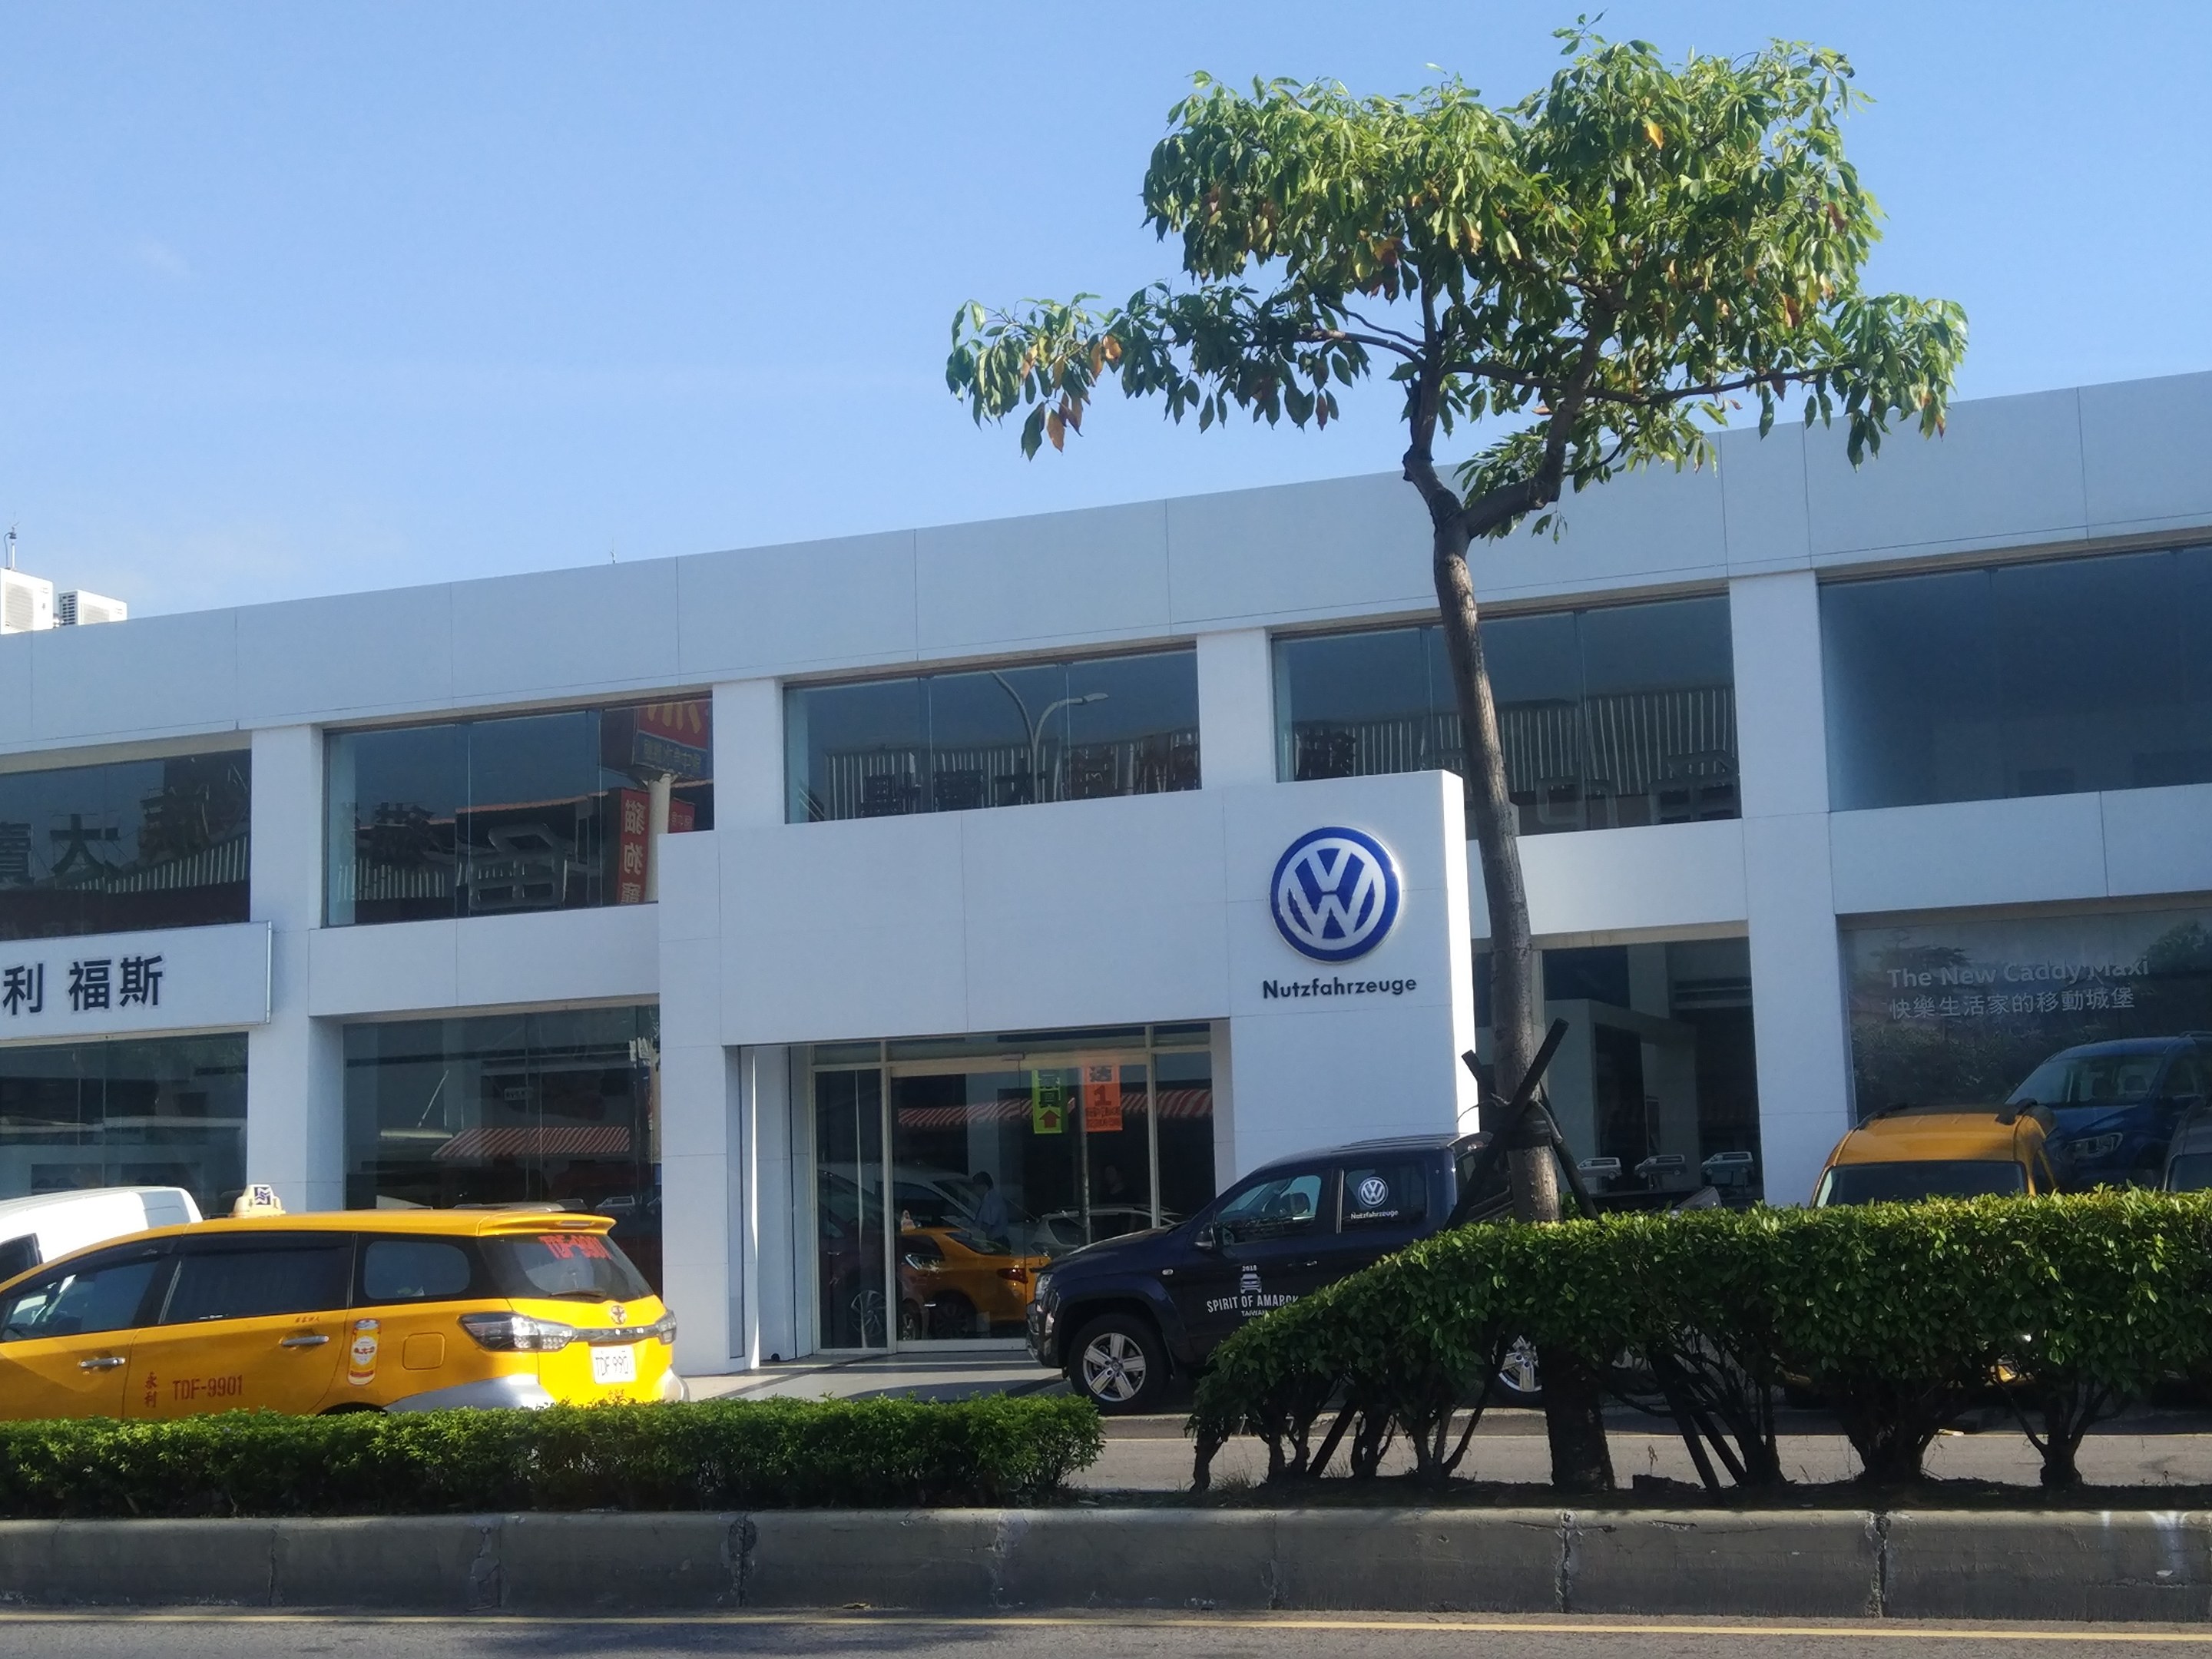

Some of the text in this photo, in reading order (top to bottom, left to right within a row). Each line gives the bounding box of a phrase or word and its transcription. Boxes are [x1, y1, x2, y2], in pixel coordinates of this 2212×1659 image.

[1887, 955, 2150, 988] The New Caddy Maxi
[3, 955, 163, 1016] 利 福斯
[1263, 976, 1417, 999] Nutzfahrzeuge
[1889, 986, 2135, 1020] 快樂生活家的移動城堡
[1350, 1208, 1399, 1220] Nutzfahrzeuge
[1206, 1296, 1239, 1313] SPIRIT
[1240, 1294, 1254, 1308] OF
[172, 1375, 243, 1402] TDF-9901
